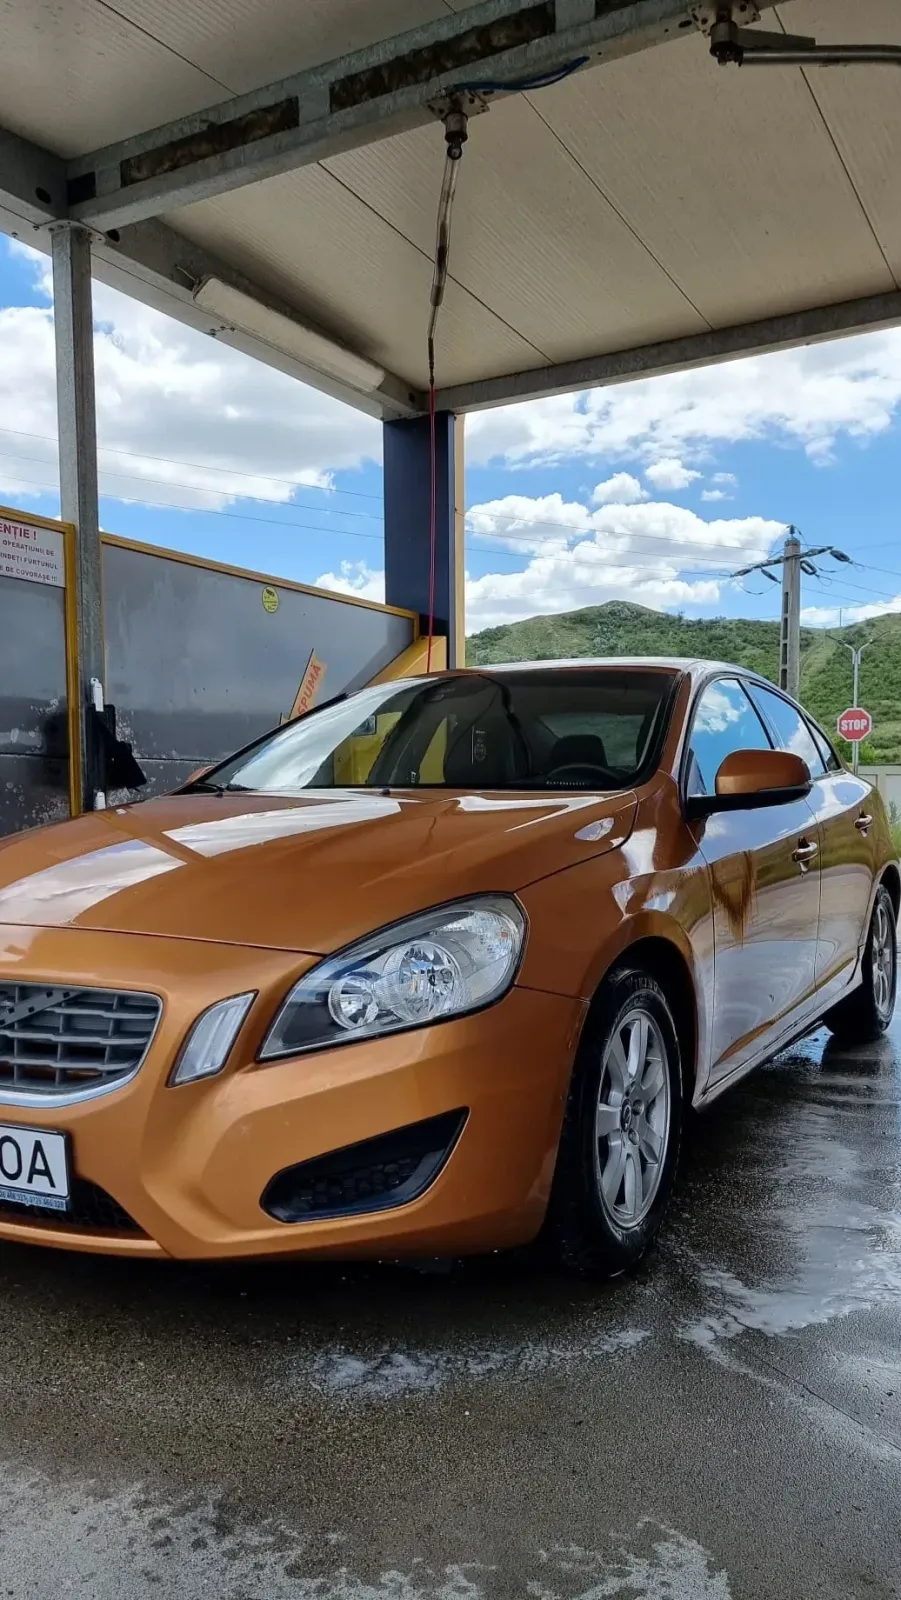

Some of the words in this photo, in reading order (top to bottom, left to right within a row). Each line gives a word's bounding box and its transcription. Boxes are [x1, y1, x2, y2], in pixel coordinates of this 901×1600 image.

[46, 549, 55, 557] DE
[23, 557, 58, 570] FURTUNUL
[841, 718, 868, 731] STOP
[0, 1135, 56, 1189] OA
